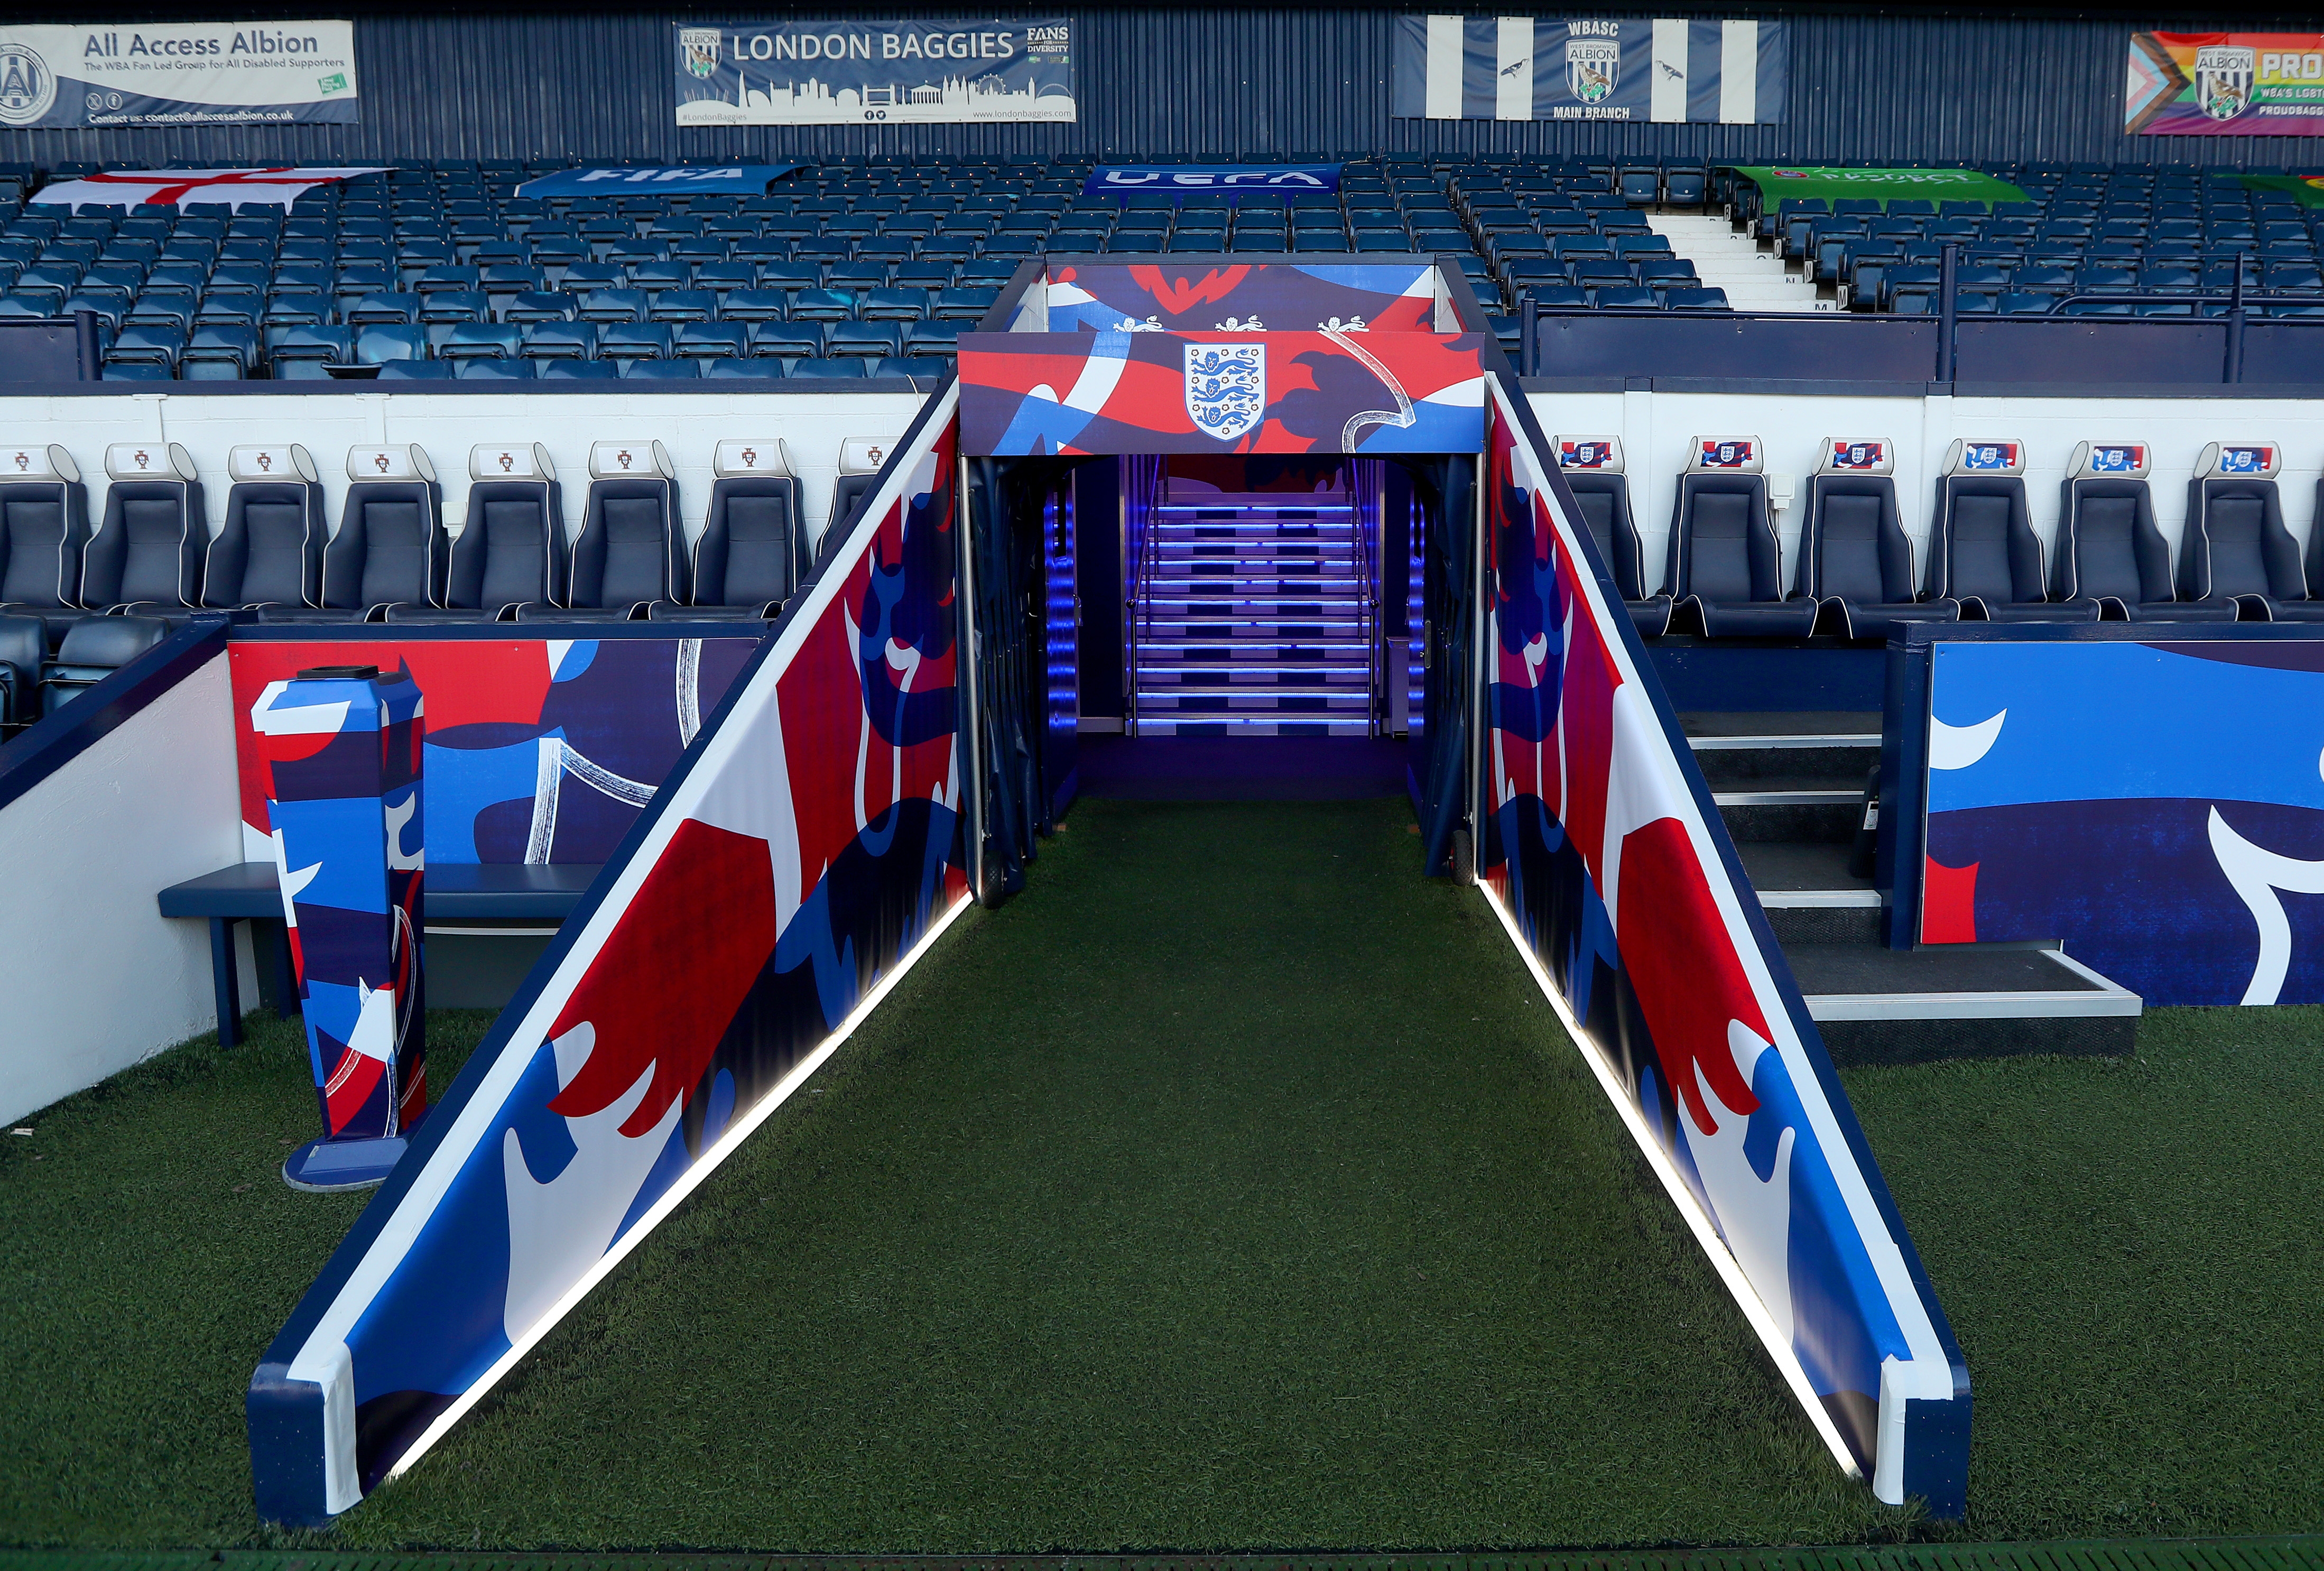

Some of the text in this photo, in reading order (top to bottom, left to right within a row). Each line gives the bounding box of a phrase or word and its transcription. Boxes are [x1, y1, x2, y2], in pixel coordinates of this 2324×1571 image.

[1026, 26, 1069, 40] FANS
[1568, 20, 1619, 37] WBASC
[84, 30, 318, 57] All Access Albion
[733, 32, 1014, 60] LONDON BAGGIES
[1570, 50, 1616, 59] ALBION
[85, 62, 101, 71] The
[134, 61, 151, 70] Fan
[154, 60, 172, 70] Led
[175, 60, 206, 71] Group
[210, 59, 224, 69] for
[226, 59, 240, 68] All
[243, 59, 286, 68] Disabled
[289, 58, 345, 69] Supporters
[2198, 58, 2250, 69] ALBION
[2262, 53, 2324, 79] PRO
[2295, 88, 2324, 98] LGBT
[88, 114, 128, 124] Contact
[145, 110, 294, 123] contact@allaccessalbion.co.uk
[683, 113, 747, 122] #LondonBaggies
[973, 110, 1071, 118] www.londonbaggies.com
[1553, 107, 1629, 118] MAIN BRANCH
[577, 168, 742, 182] FIFA
[1105, 172, 1322, 184] UEFA
[1806, 264, 1811, 279] N
[1839, 289, 1846, 306] M
